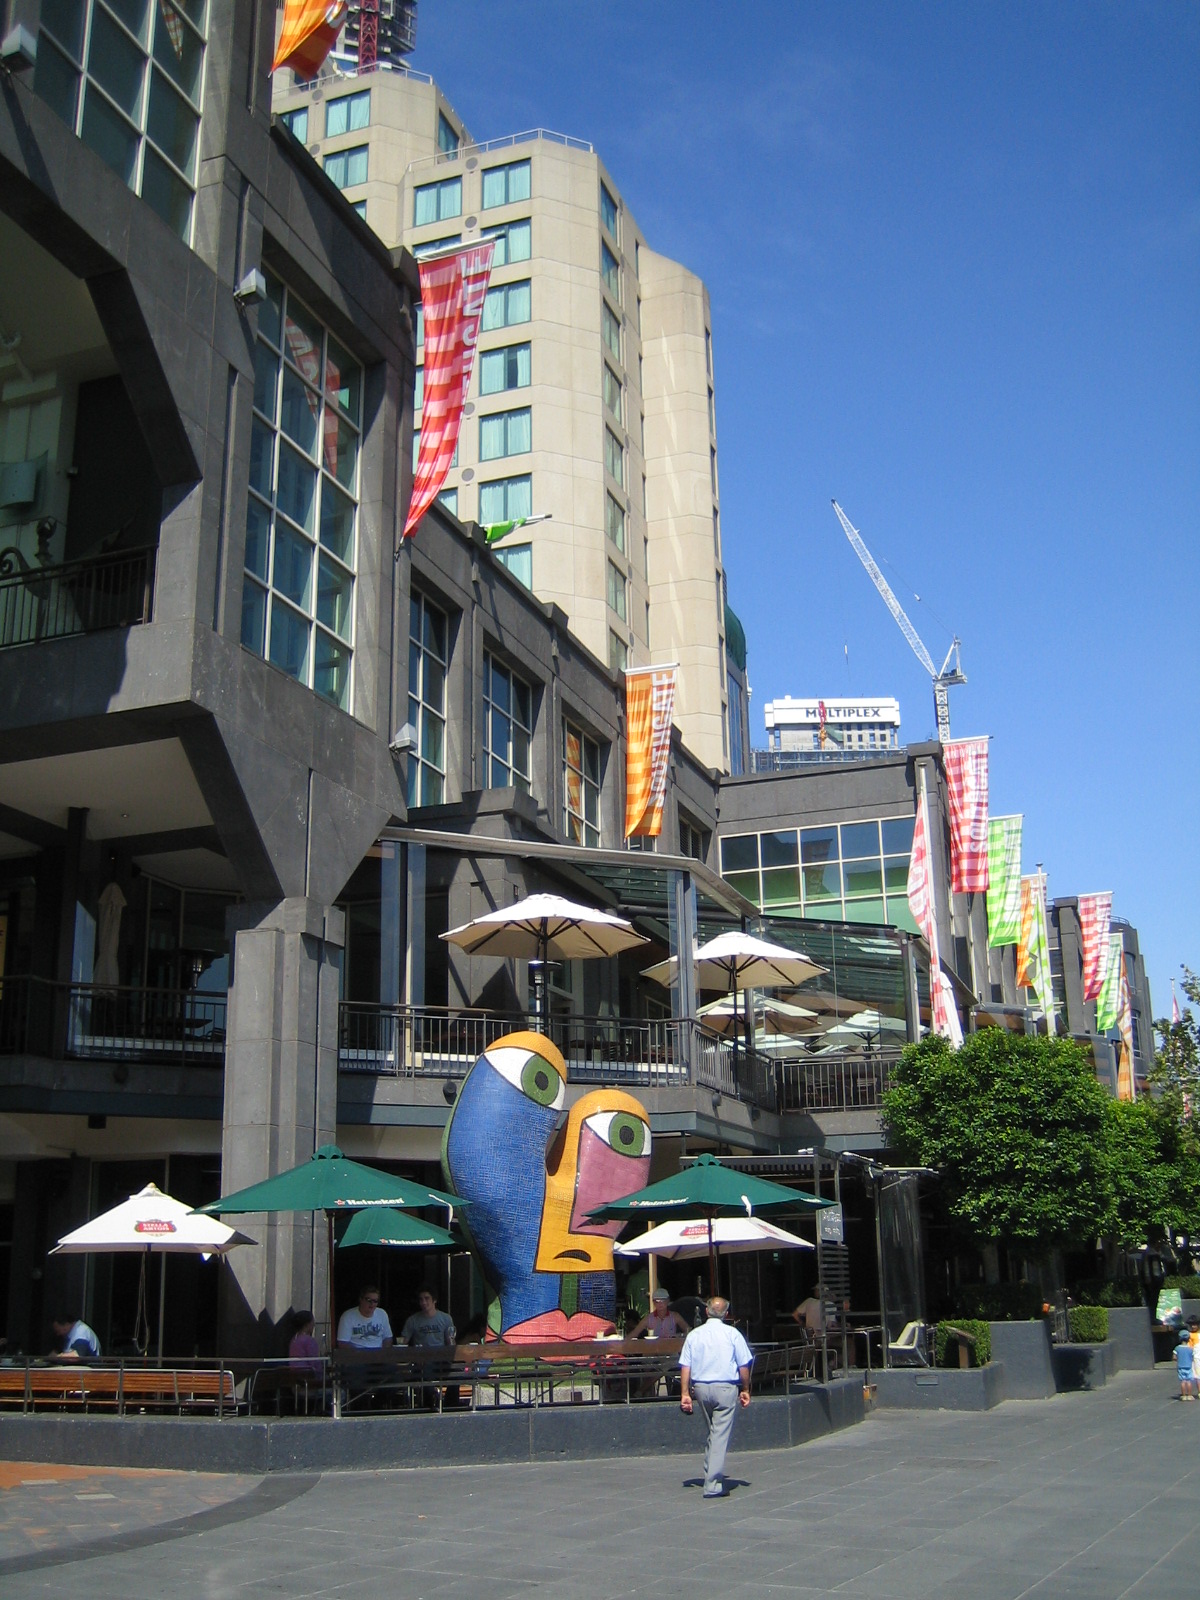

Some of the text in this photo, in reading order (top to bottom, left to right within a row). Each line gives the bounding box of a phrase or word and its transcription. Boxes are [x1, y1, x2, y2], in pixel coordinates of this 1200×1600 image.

[805, 707, 882, 718] MLTIPLEX
[648, 671, 677, 809] SOUTHGATE
[346, 1197, 405, 1205] Heineken
[639, 1197, 689, 1206] Heineken
